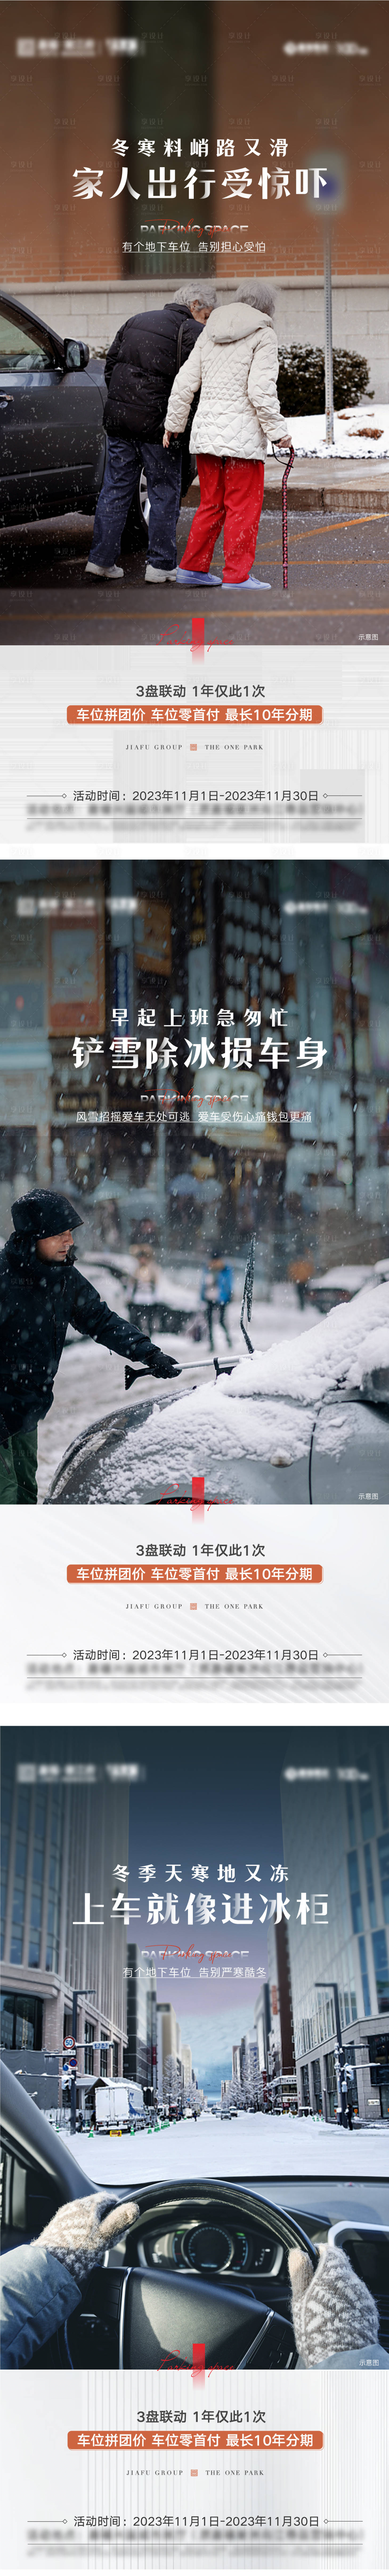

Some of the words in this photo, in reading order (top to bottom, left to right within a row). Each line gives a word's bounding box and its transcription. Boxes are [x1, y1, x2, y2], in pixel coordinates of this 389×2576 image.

[112, 138, 288, 157] 冬寒料峭路又滑
[72, 167, 327, 199] 家人出行受惊吓
[122, 241, 190, 251] 有个地下车位
[198, 241, 265, 251] 告别担心受怕
[136, 684, 186, 698] 3盘联动
[193, 684, 265, 698] 1年仅此1次
[77, 708, 145, 721] 车位拼团价
[151, 708, 220, 721] 车位零首付
[225, 708, 312, 721] 最长10年分期
[111, 1008, 288, 1027] 早起上班急匆忙
[72, 1037, 327, 1069] 铲雪除冰损车身
[76, 1111, 190, 1121] 风雪招摇爱车无处可逃
[198, 1111, 311, 1121] 爱车受伤心痛钱包更痛
[136, 1544, 186, 1557] 3盘联动
[193, 1543, 265, 1557] 1年仅此1次
[77, 1567, 145, 1580] 车位拼团价
[151, 1567, 220, 1580] 车位零首付
[225, 1567, 312, 1580] 最长10年分期
[112, 1864, 288, 1883] 冬季天寒地又冻
[73, 1892, 328, 1925] 上车就像进冰柜
[123, 1967, 191, 1977] 有个地下车位
[199, 1967, 266, 1977] 告别严寒酷冬
[137, 2410, 187, 2423] 3盘联动
[193, 2410, 266, 2423] 1年仅此1次
[77, 2434, 146, 2447] 车位拼团价
[152, 2434, 220, 2447] 车位零首付
[226, 2434, 313, 2447] 最长10年分期
